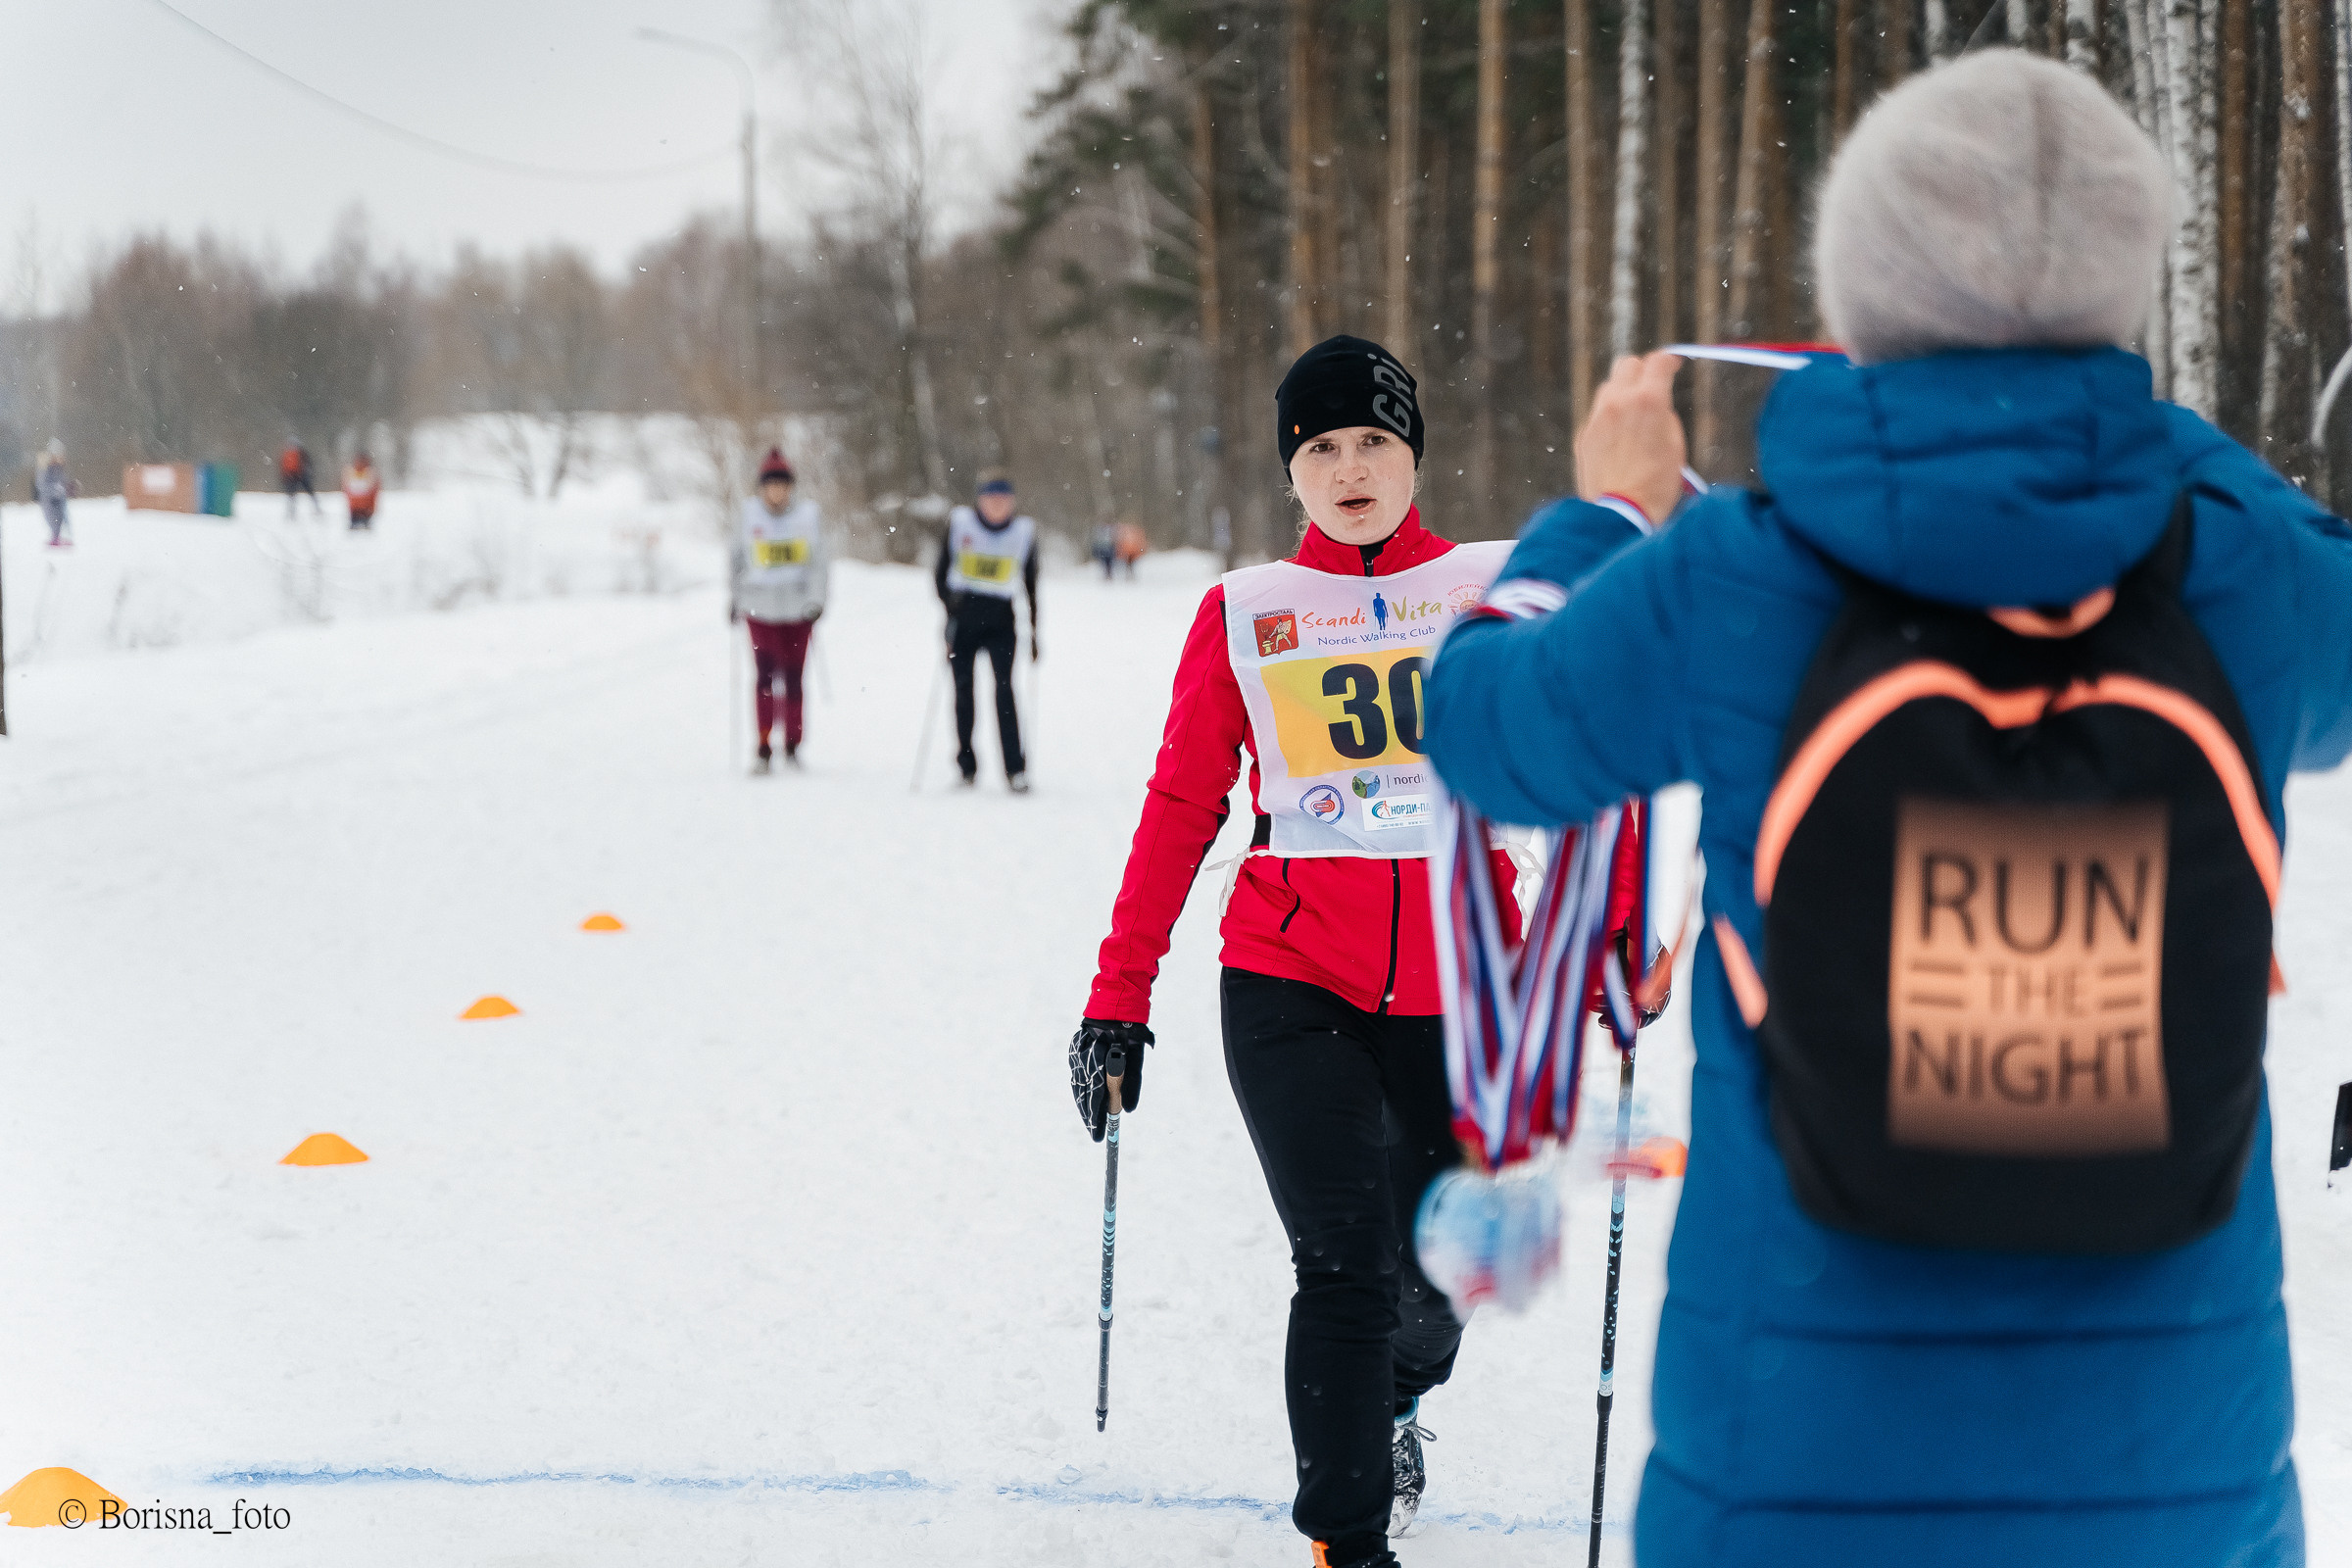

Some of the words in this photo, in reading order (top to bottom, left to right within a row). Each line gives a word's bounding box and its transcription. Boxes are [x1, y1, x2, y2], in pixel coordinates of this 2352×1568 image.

[1301, 608, 1366, 629] Scandi
[1392, 595, 1443, 622] Vita
[1317, 634, 1357, 647] Nordic
[1359, 628, 1407, 643] Walking
[1409, 625, 1437, 639] Club
[1919, 850, 2151, 956] RUN
[1988, 961, 2089, 1019] THE
[1902, 1026, 2149, 1108] NIGHT
